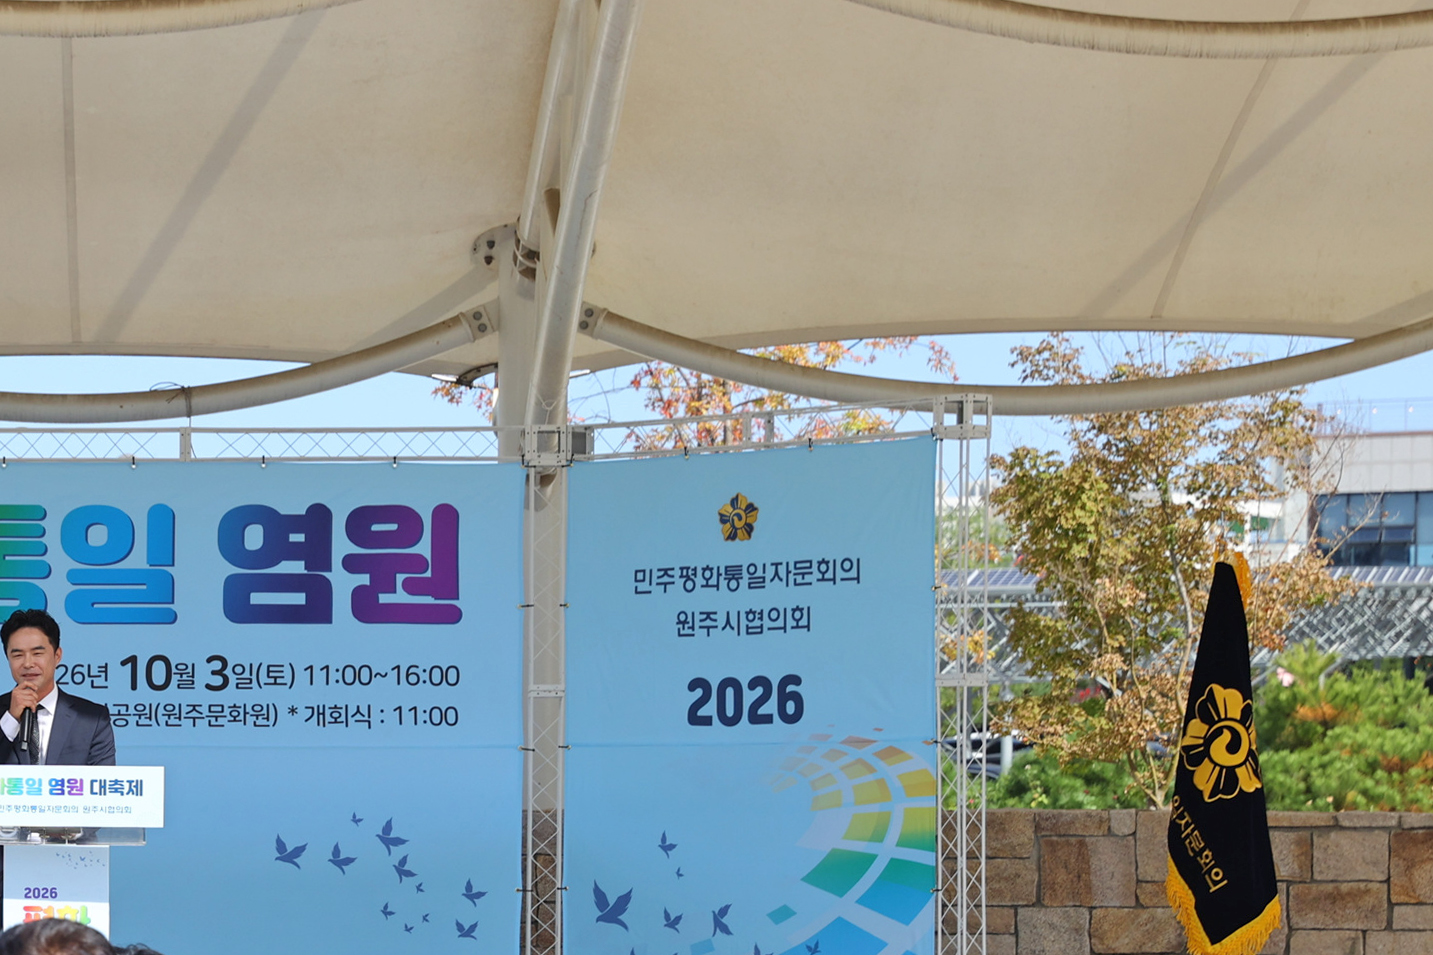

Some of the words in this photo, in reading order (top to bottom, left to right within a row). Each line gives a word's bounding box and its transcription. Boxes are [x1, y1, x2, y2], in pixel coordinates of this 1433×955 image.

[217, 503, 463, 625] 염원
[633, 557, 862, 595] 민주평화통일자문회의
[675, 605, 812, 637] 원주시협의회
[56, 662, 109, 689] 26년
[120, 654, 196, 692] 10월
[303, 664, 461, 687] 11:00~16:00
[104, 702, 278, 728] 공원(원주문화원)
[304, 704, 372, 730] 개회식
[393, 705, 459, 727] 11:00
[687, 673, 804, 727] 2026
[48, 778, 84, 796] 염원
[89, 779, 143, 797] 대축제
[24, 887, 58, 899] 2026
